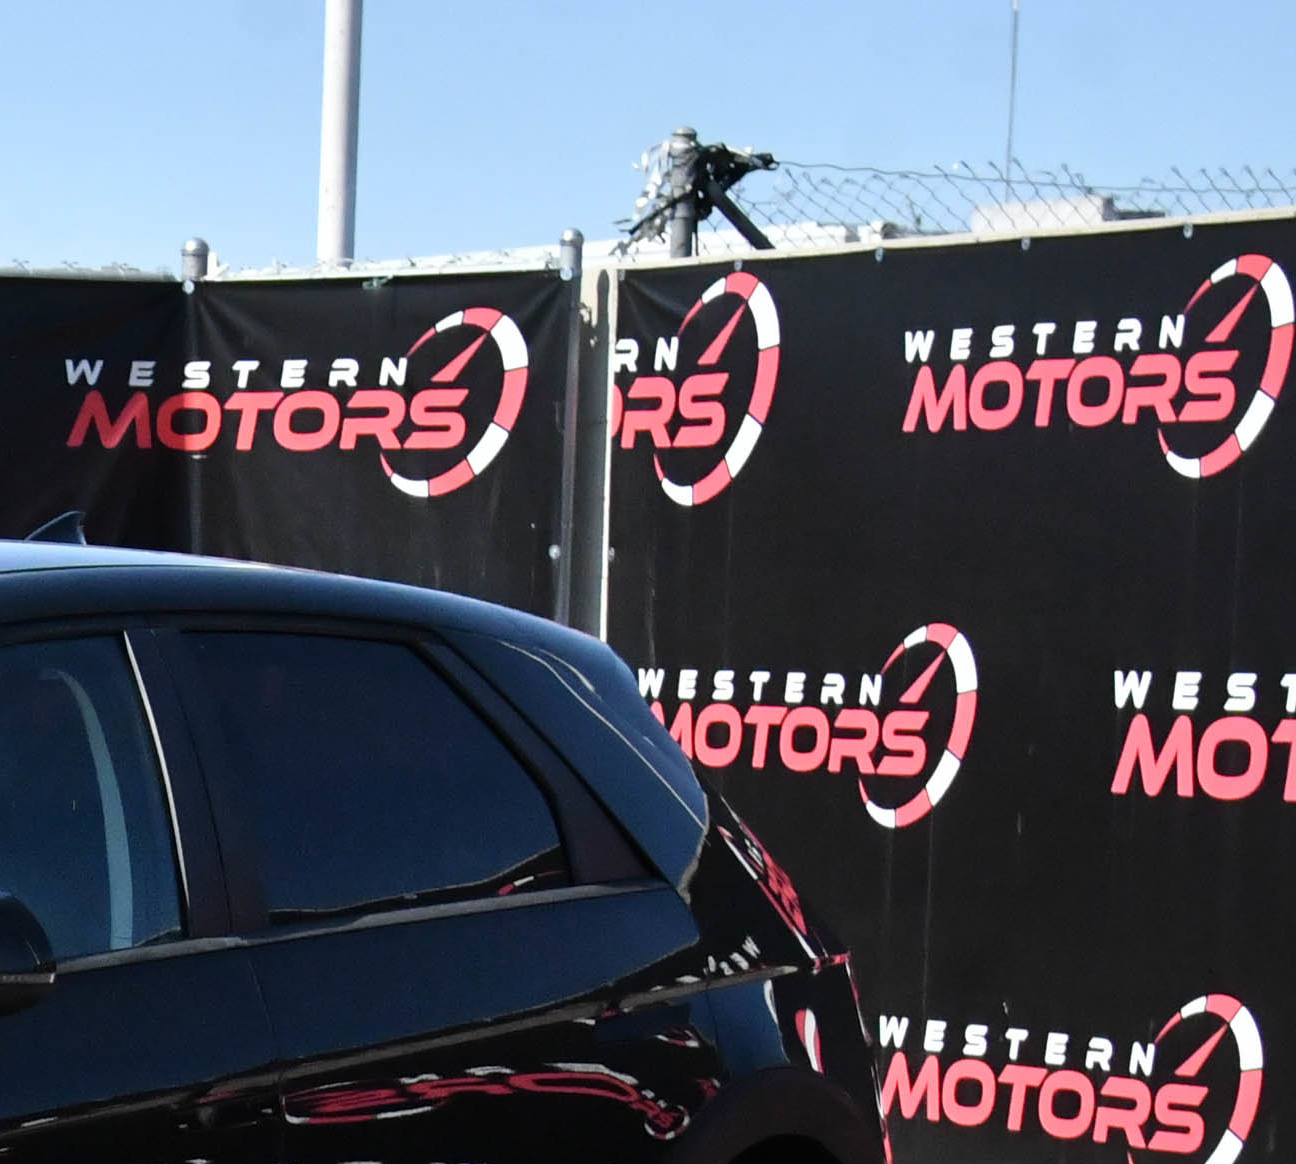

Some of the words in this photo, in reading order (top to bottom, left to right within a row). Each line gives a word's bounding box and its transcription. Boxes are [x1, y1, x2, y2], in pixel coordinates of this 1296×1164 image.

[904, 313, 1186, 364] WESTERN
[65, 356, 408, 389] WESTERN
[902, 349, 1240, 434] MOTORS
[66, 390, 470, 453] MOTORS
[611, 372, 730, 450] RS
[638, 668, 883, 706] WESTERN
[879, 1014, 1157, 1077] WESTERN
[881, 1050, 1210, 1155] MOTORS
